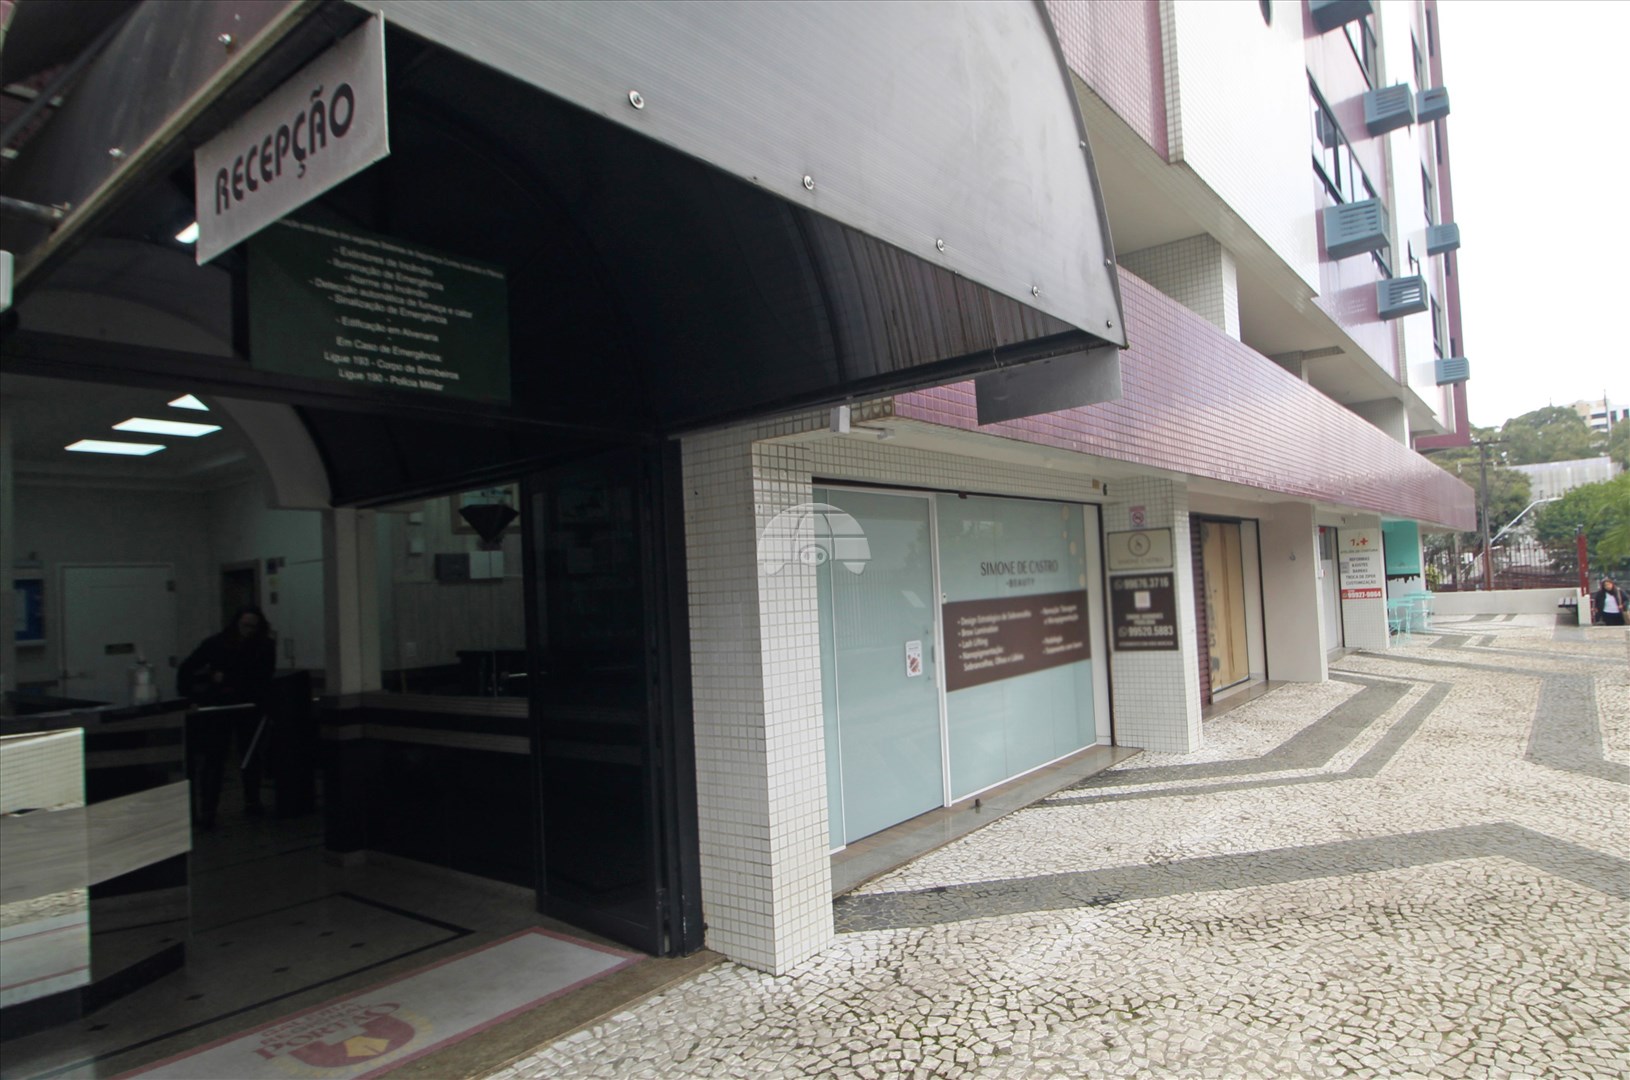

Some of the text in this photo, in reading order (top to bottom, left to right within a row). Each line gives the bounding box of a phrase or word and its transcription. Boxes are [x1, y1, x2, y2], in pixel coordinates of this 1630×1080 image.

[215, 82, 356, 216] RECEPÇÃO
[385, 258, 398, 268] de
[399, 260, 434, 277] Incêndio
[350, 273, 430, 299] Alarme de Incêndio
[383, 269, 395, 279] de
[395, 271, 445, 292] Emergência
[406, 297, 417, 307] de
[386, 305, 398, 315] de
[399, 306, 449, 325] Emergência
[387, 326, 401, 335] em
[336, 335, 353, 348] Em
[354, 339, 379, 352] Caso
[380, 345, 391, 355] de
[324, 350, 351, 366] Ligue
[376, 358, 404, 376] Corpo
[404, 364, 416, 374] de
[417, 364, 460, 380] Bombeiros
[339, 367, 364, 382] Ligue
[366, 371, 384, 384] 190
[419, 379, 445, 392] Militar
[981, 559, 1059, 577] SIMONE DE CASTRO
